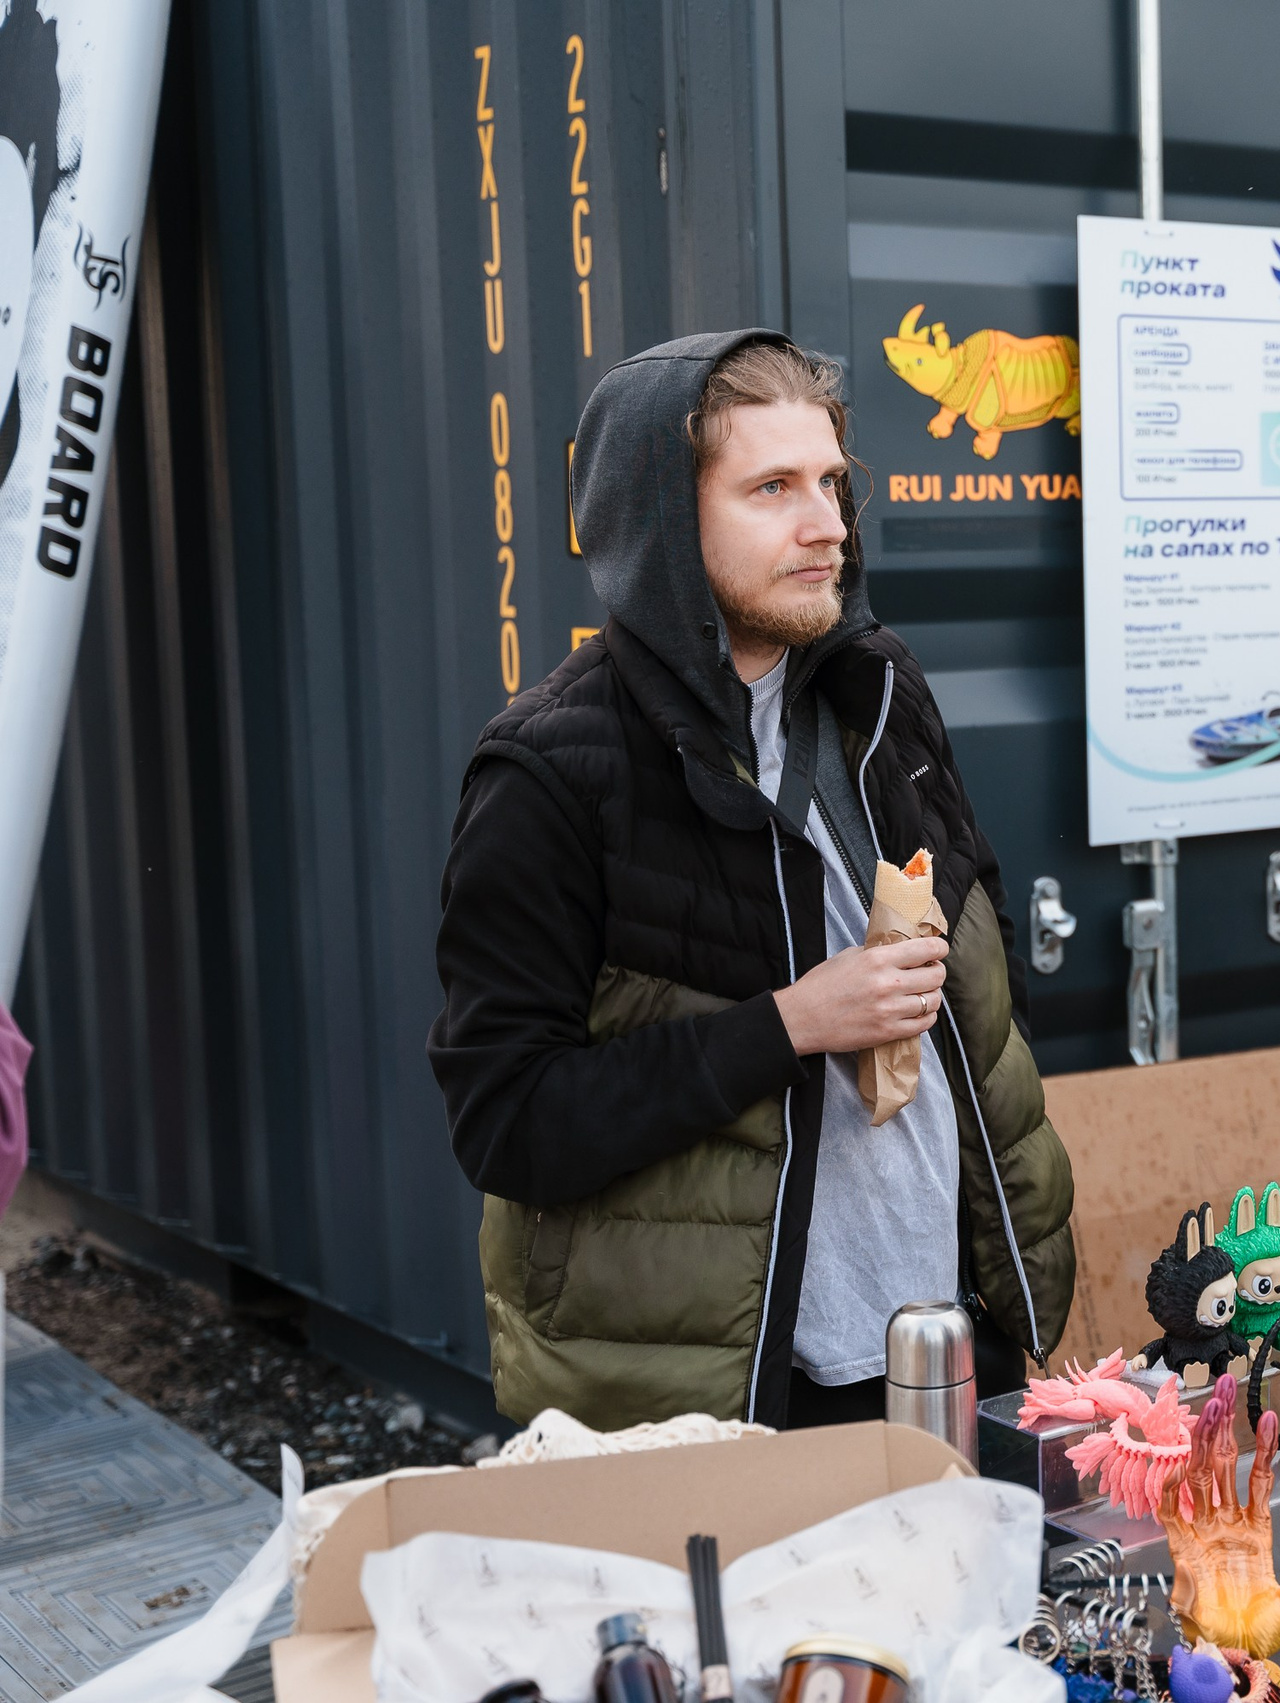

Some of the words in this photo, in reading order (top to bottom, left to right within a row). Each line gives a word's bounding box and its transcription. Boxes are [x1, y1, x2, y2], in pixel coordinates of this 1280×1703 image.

[565, 35, 592, 358] 22G1
[1121, 251, 1199, 274] Пункт
[1120, 279, 1226, 299] проката
[475, 45, 503, 354] ZXJU
[490, 393, 520, 707] 0820
[36, 324, 112, 580] BOARD
[889, 474, 942, 502] RUI
[950, 474, 1013, 502] JUN
[1020, 474, 1082, 501] YUA
[1125, 516, 1246, 537] Прогулки
[1125, 543, 1154, 558] на
[1161, 542, 1233, 557] сапах
[1241, 542, 1270, 556] по
